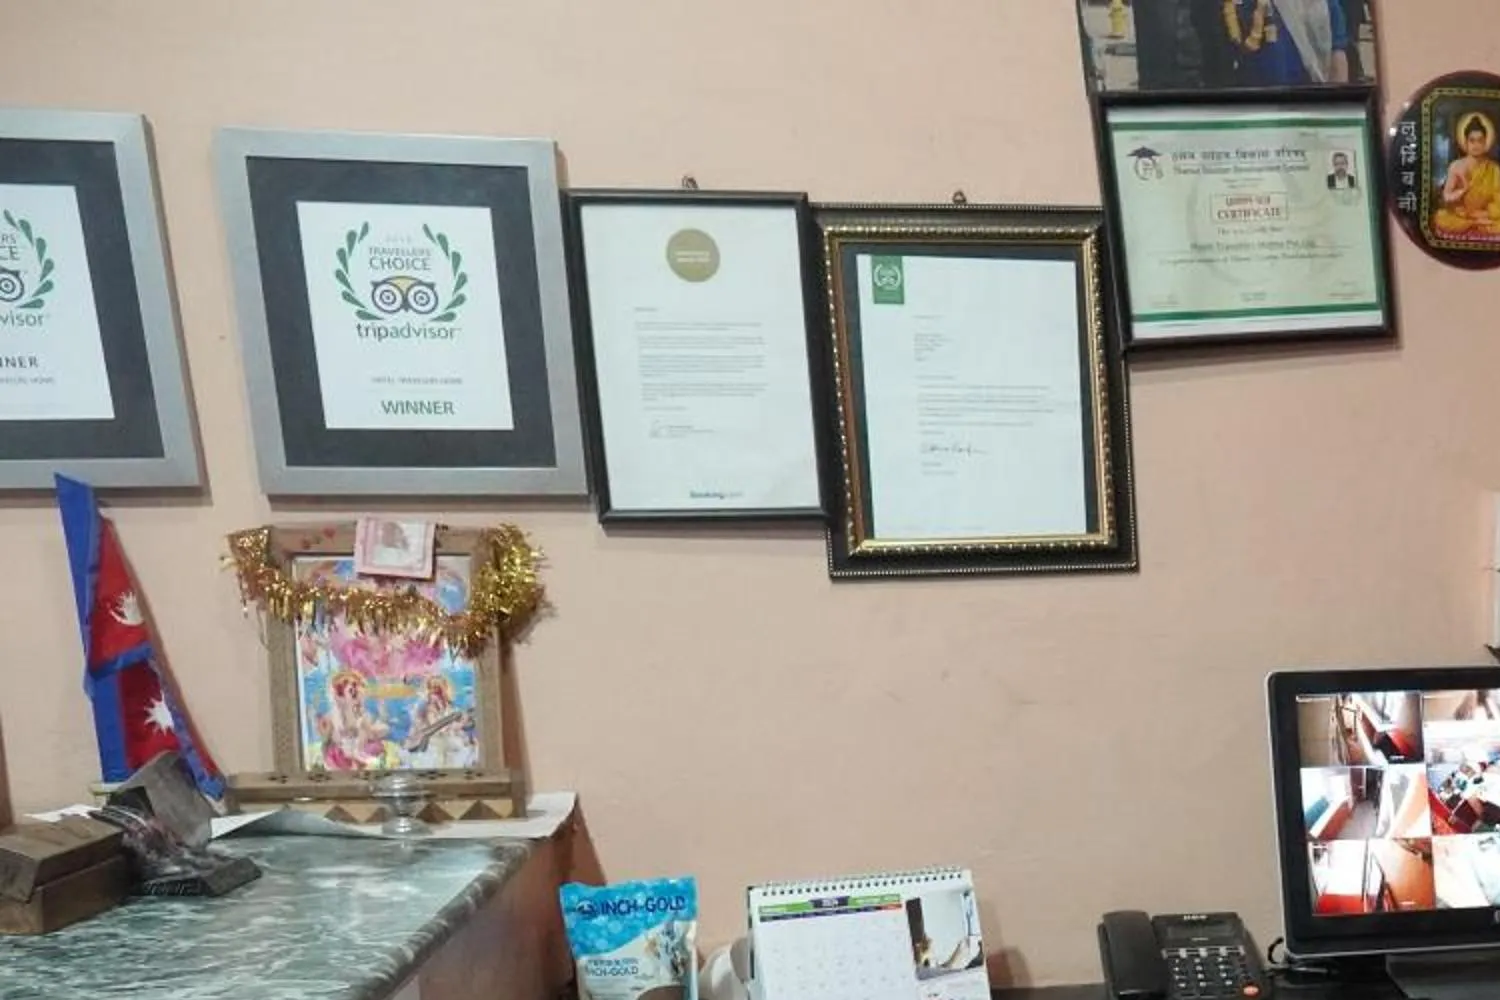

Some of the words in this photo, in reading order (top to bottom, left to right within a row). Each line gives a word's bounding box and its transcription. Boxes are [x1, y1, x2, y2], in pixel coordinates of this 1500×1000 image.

[369, 257, 431, 270] CHOICE
[356, 322, 456, 342] tripadvisor
[381, 400, 454, 415] WINNER
